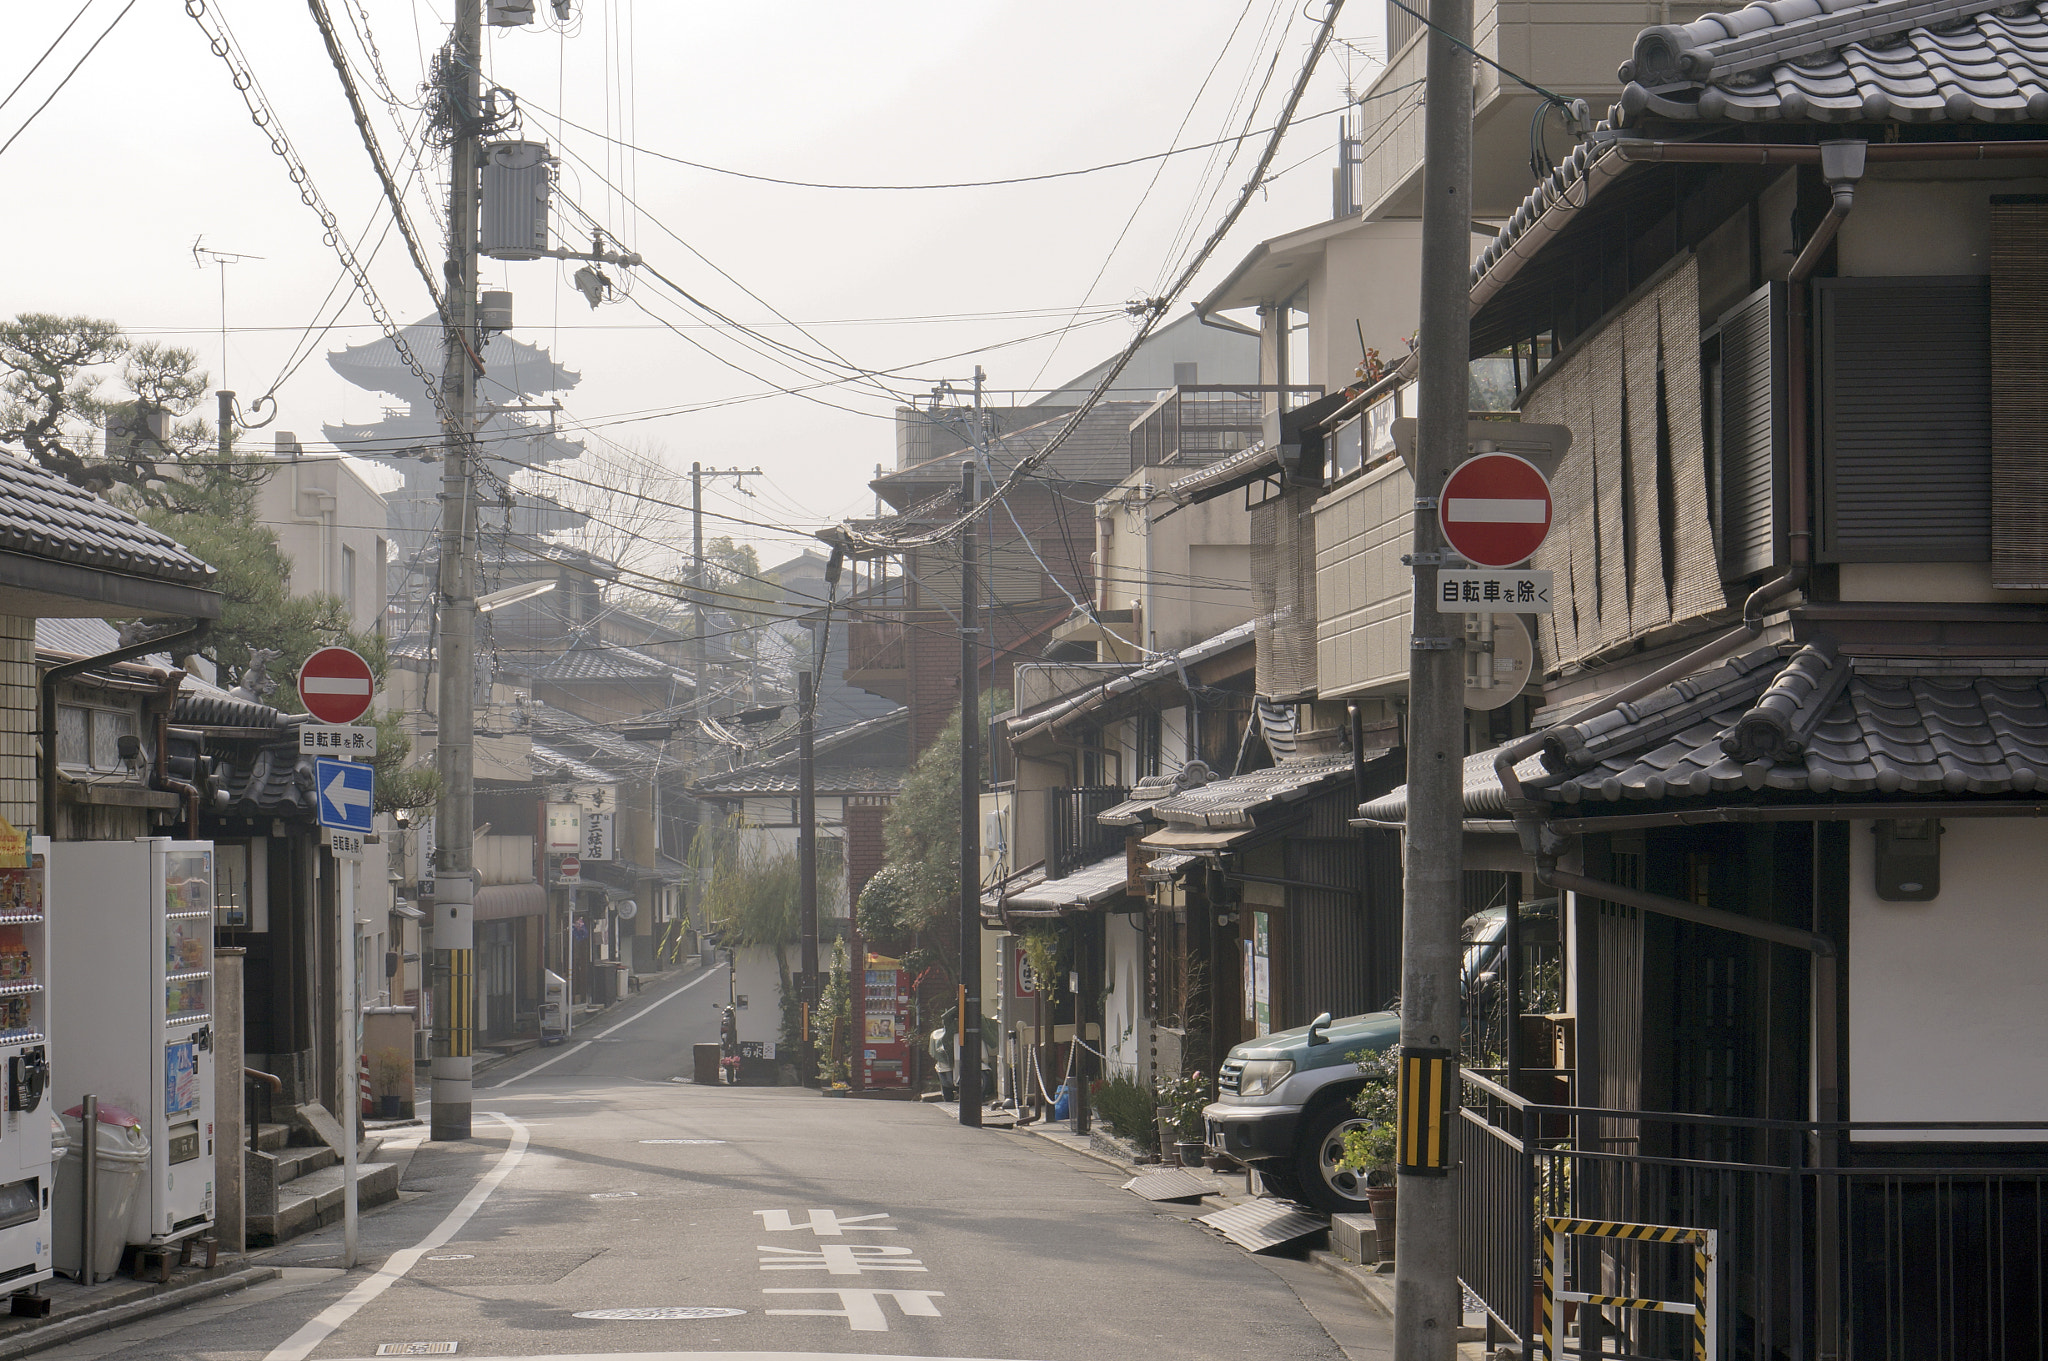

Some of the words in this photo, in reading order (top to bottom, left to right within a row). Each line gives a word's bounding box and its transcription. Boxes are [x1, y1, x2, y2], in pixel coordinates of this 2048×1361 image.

[1443, 579, 1549, 603] 自転車を除く
[303, 731, 373, 749] 自転車を除く
